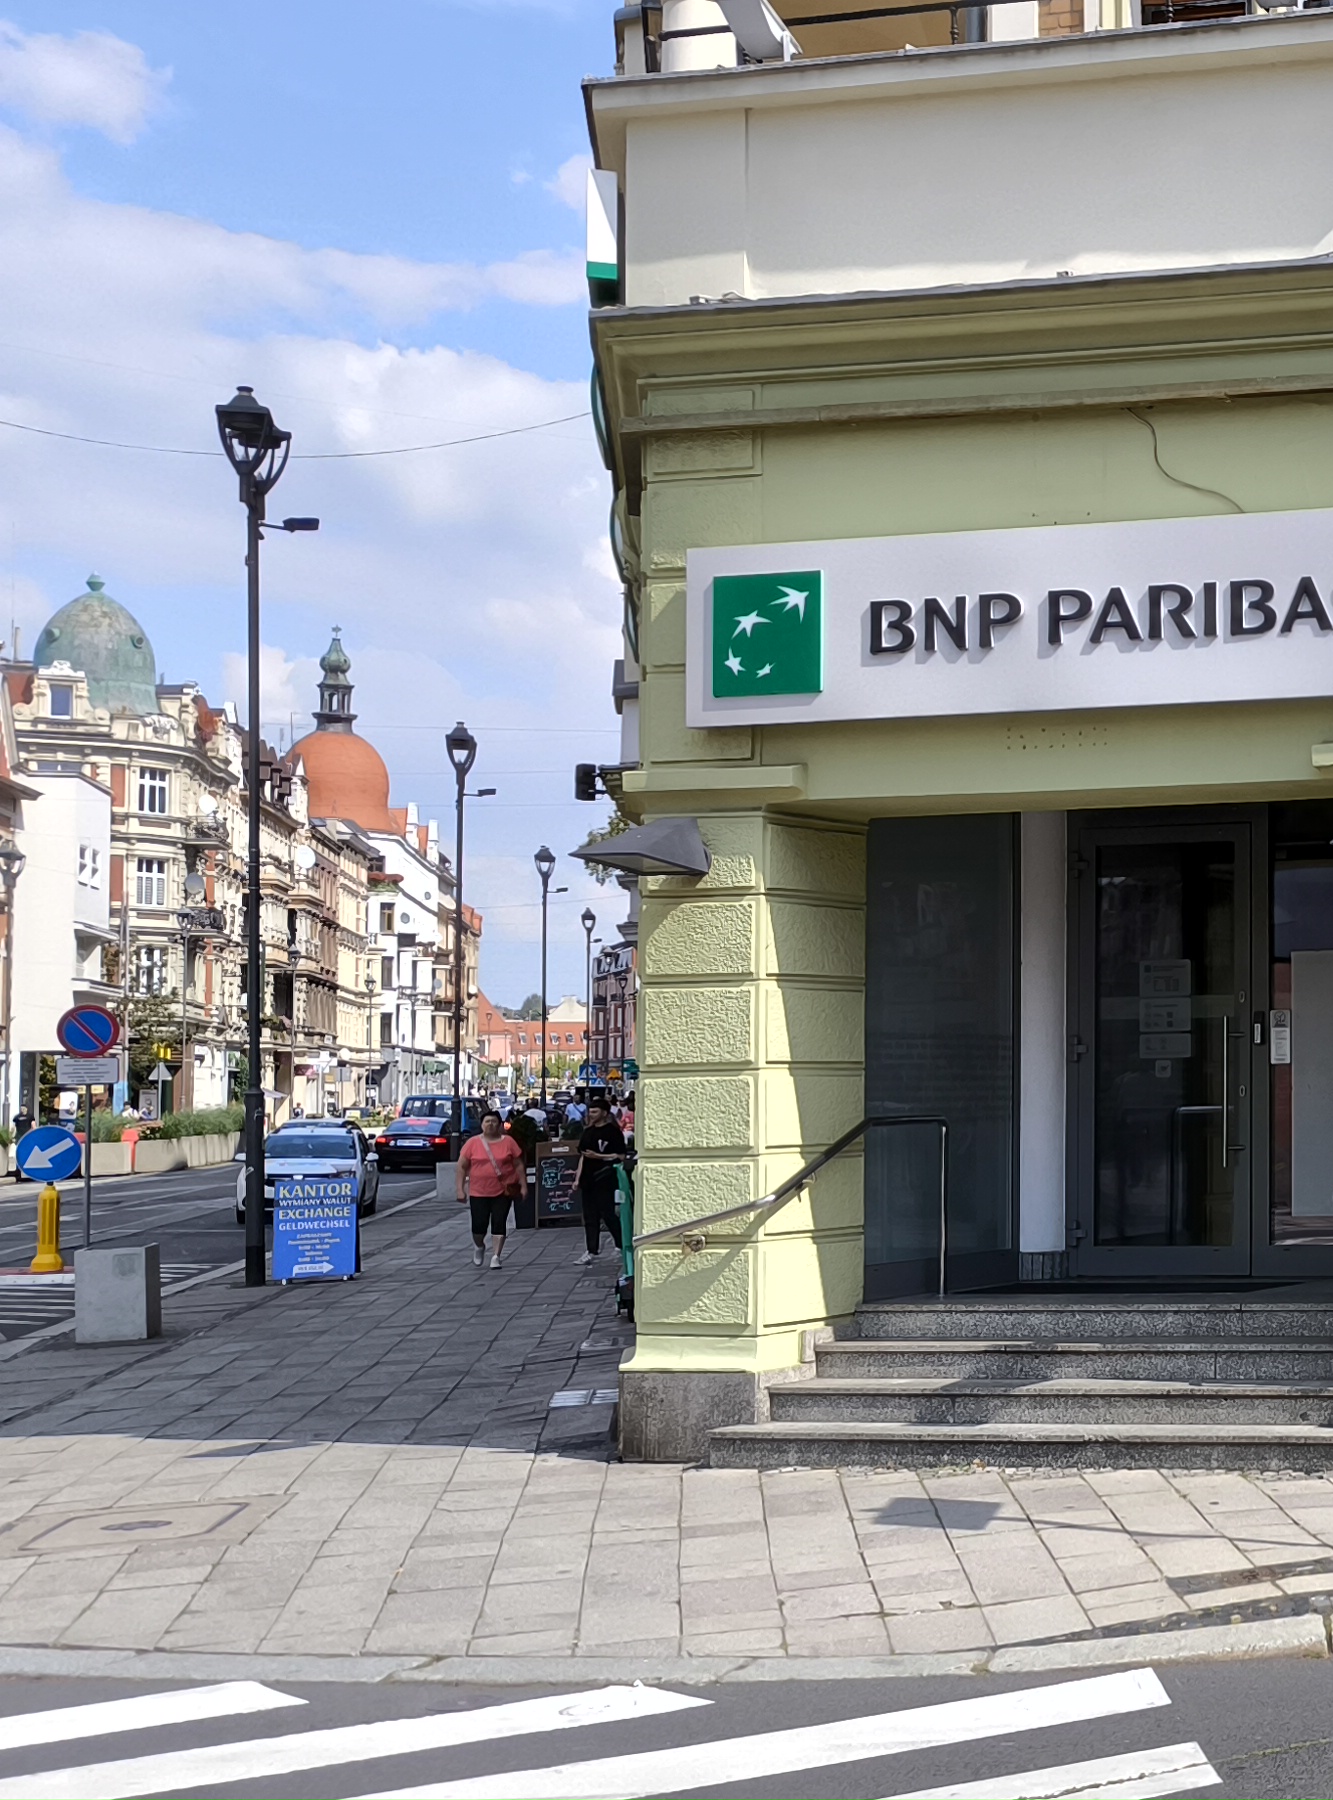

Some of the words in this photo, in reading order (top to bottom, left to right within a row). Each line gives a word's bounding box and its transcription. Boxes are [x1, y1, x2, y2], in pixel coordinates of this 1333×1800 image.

[869, 592, 1025, 655] BNP
[279, 1182, 352, 1199] KANTOR
[279, 1199, 321, 1207] WYMIANY
[323, 1197, 352, 1205] WALUT
[279, 1206, 351, 1220] EXCHANGE
[279, 1219, 351, 1231] GELDWECHSEL
